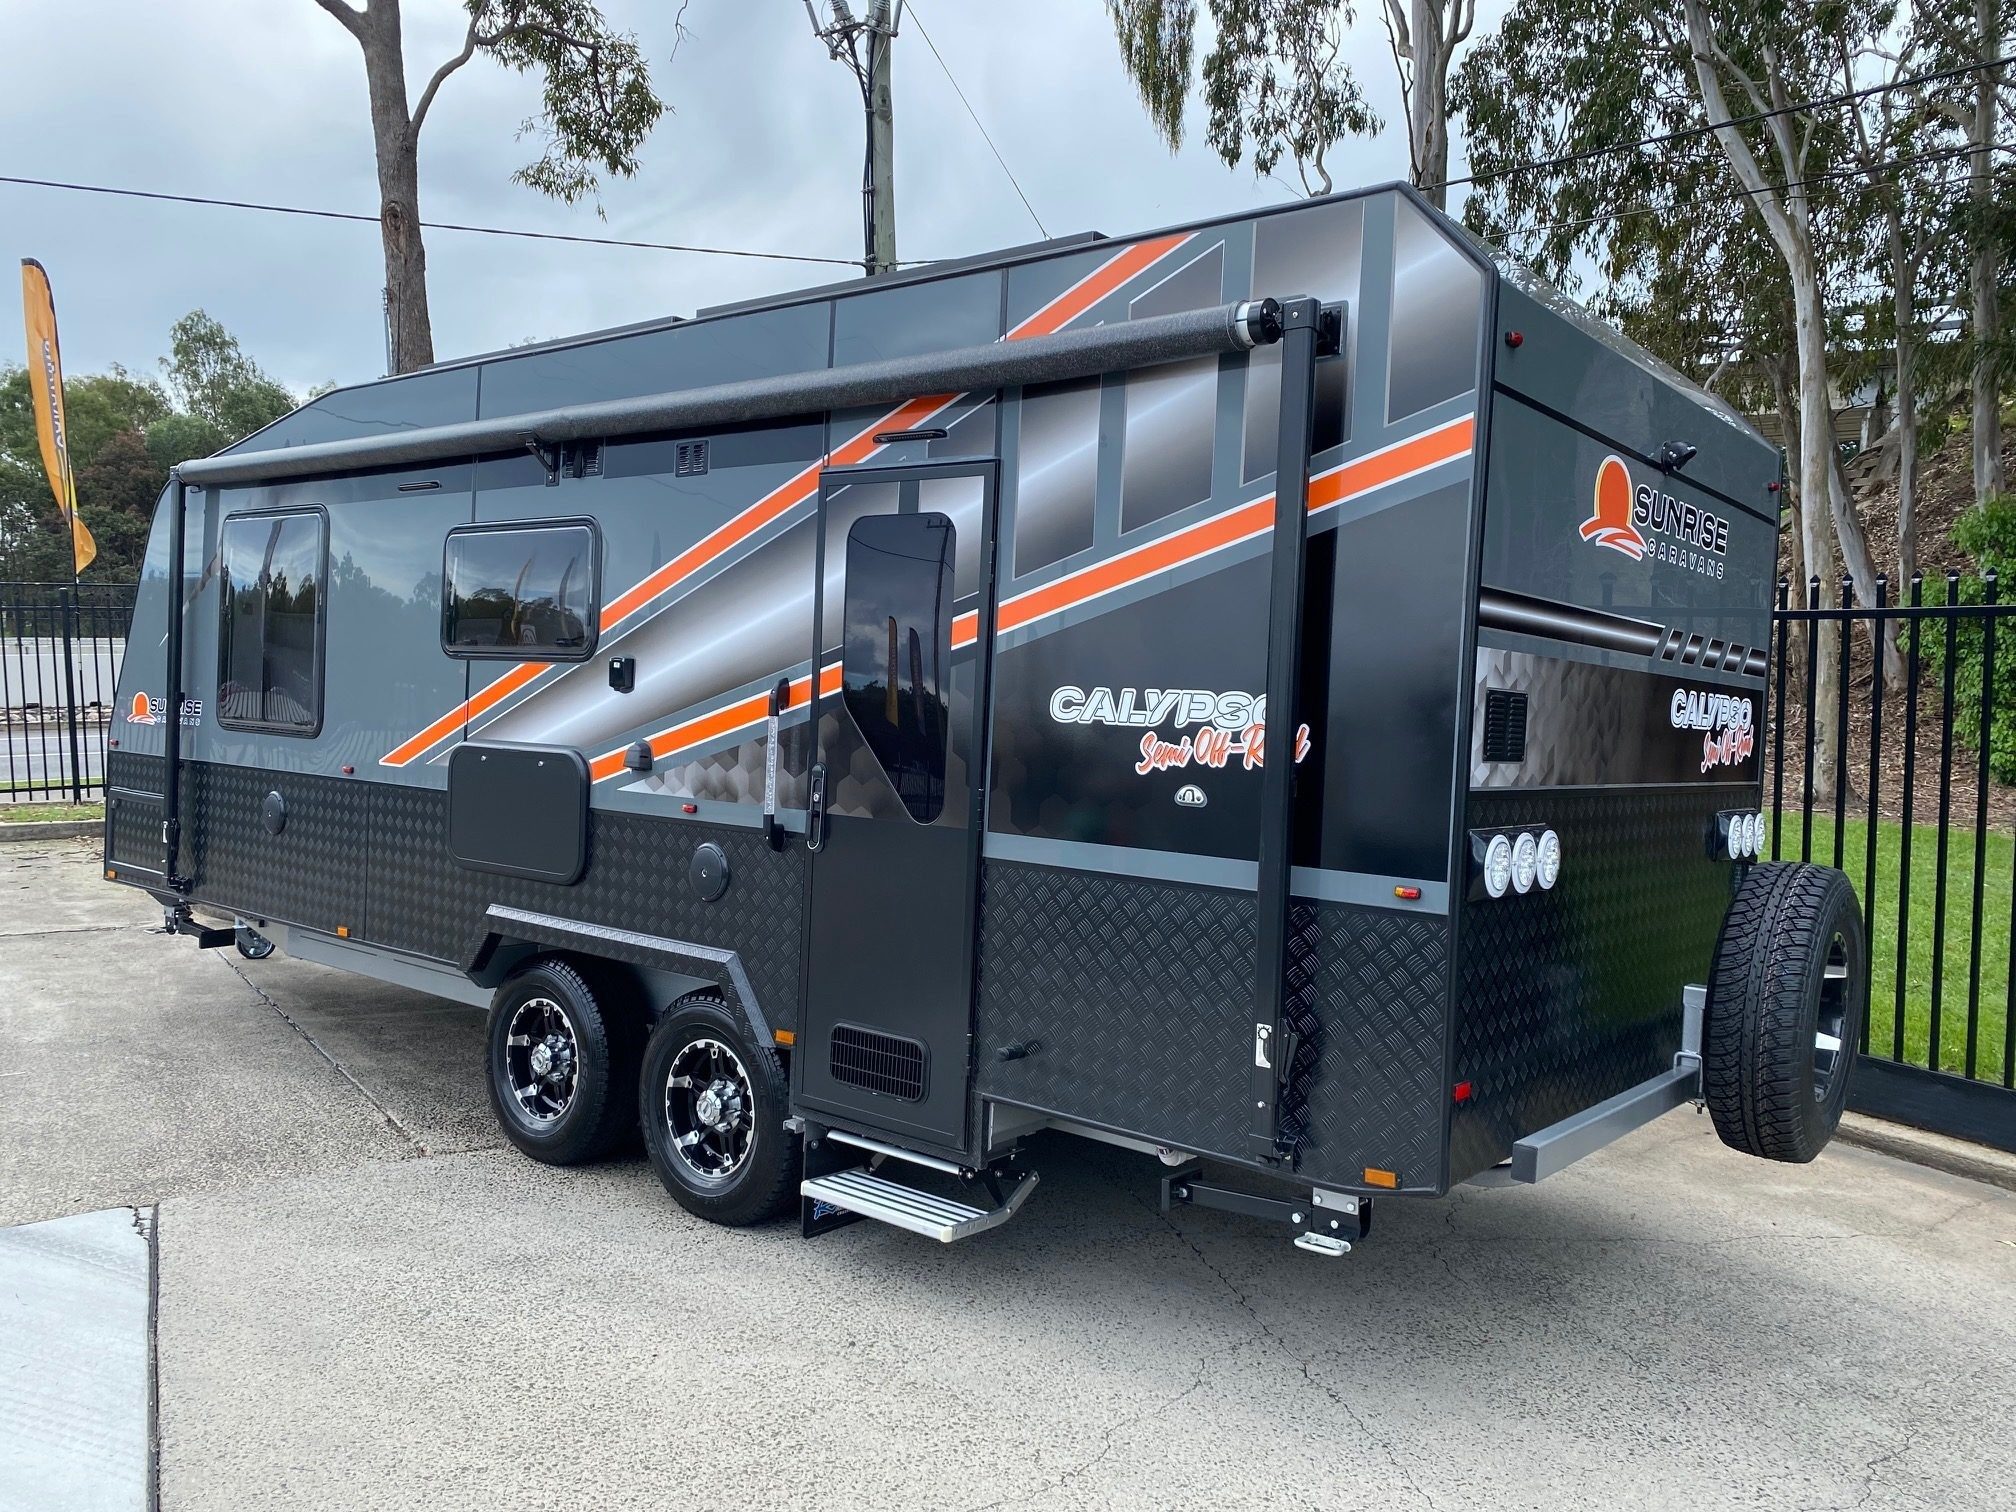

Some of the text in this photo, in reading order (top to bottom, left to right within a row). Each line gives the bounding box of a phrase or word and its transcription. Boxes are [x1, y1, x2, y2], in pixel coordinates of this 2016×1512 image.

[1633, 484, 1729, 556] SUNRISE
[1647, 538, 1724, 580] CARAVANS
[149, 697, 203, 716] SUISE
[1670, 688, 1752, 734] CALYPSO
[1135, 731, 1192, 775] Semi
